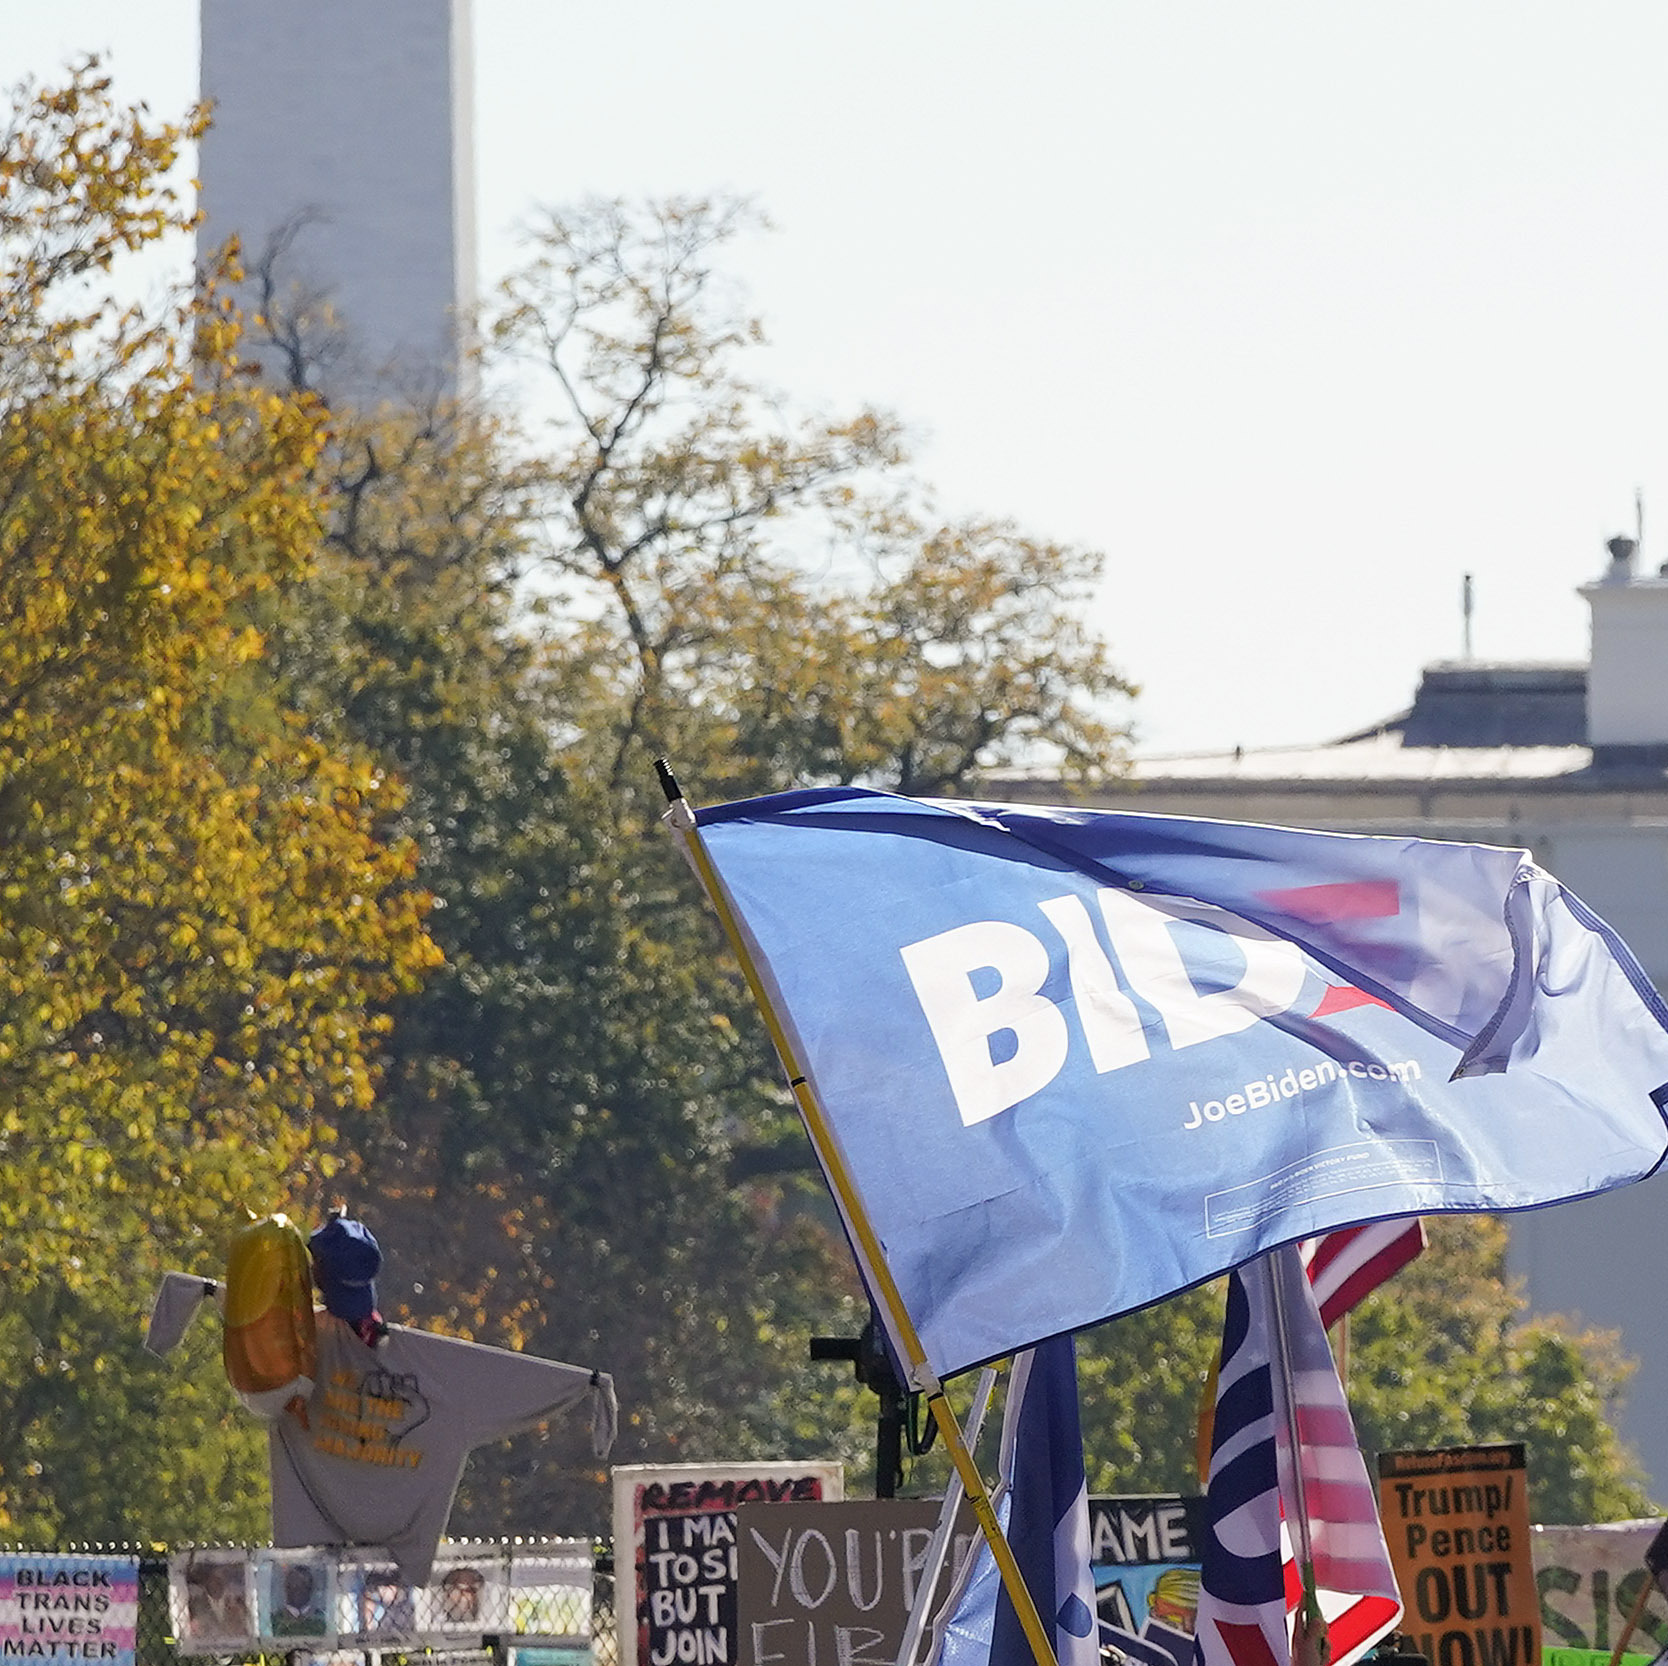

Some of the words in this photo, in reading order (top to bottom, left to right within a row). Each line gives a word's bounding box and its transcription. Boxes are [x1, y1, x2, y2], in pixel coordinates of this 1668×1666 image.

[899, 886, 1340, 1128] BID
[1182, 1058, 1424, 1131] JoeBiden.com
[1394, 1474, 1514, 1519] Trump/
[657, 1519, 670, 1550] I
[1091, 1506, 1191, 1563] AME
[1405, 1522, 1512, 1559] Pence
[16, 1567, 112, 1588] BLACK
[649, 1551, 698, 1588] TO
[749, 1526, 972, 1613] YOU'R
[15, 1591, 111, 1612] TRANS
[651, 1584, 727, 1628] BUT
[1415, 1561, 1512, 1624] OUT
[21, 1615, 102, 1635] LIVES
[3, 1637, 118, 1659] MATTER
